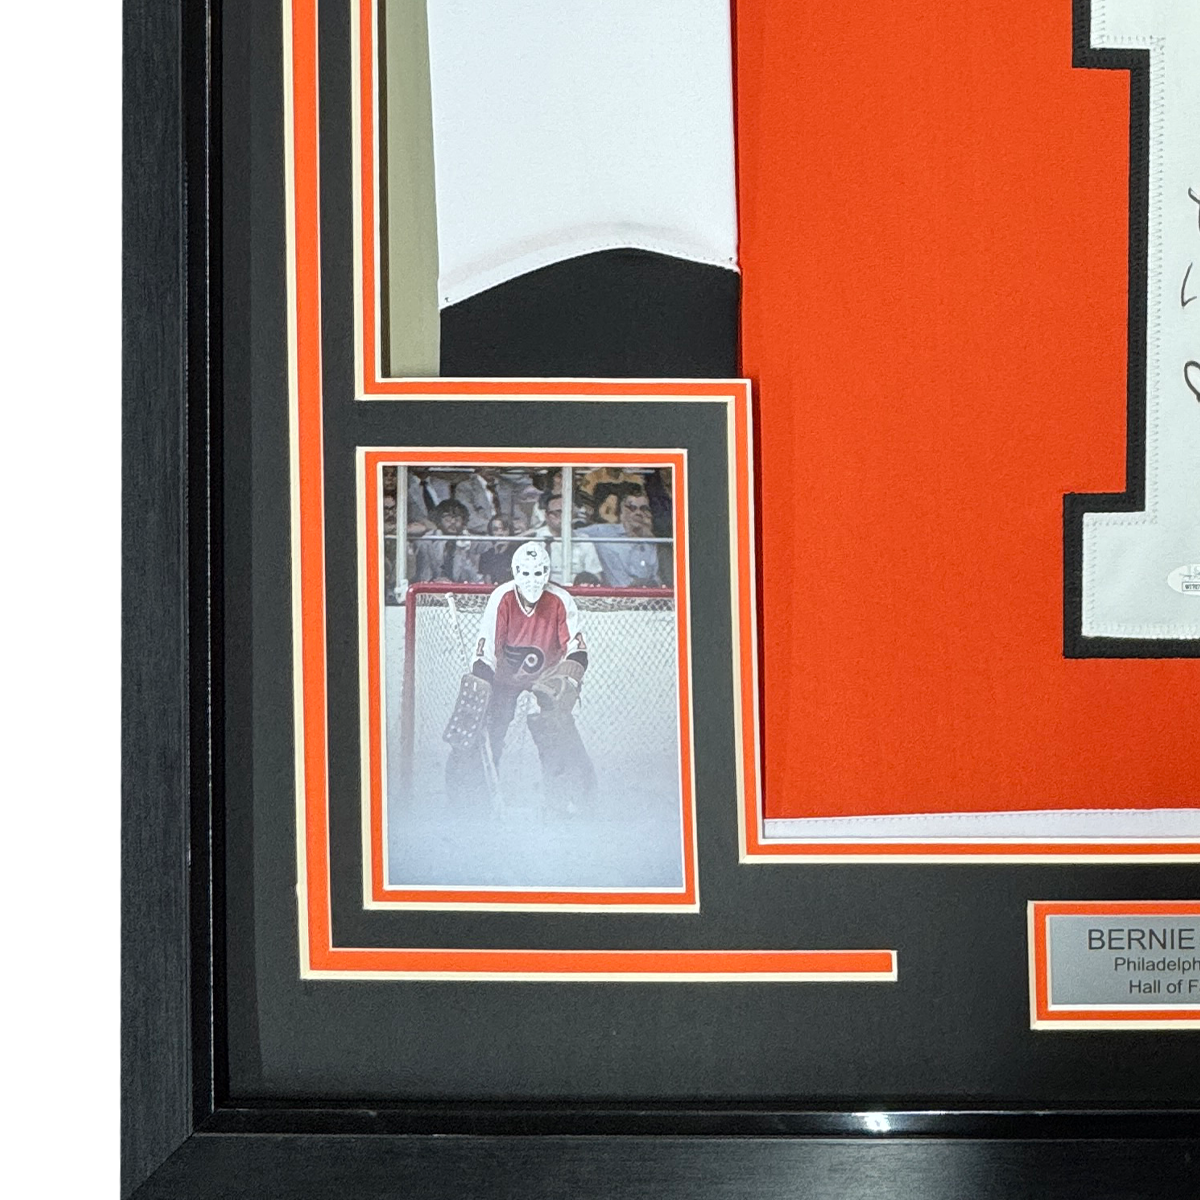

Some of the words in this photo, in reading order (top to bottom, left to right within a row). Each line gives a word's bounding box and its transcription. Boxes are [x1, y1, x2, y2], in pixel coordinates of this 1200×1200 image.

[1087, 928, 1196, 950] BERNIE
[1129, 979, 1161, 994] Hall
[1166, 979, 1184, 994] of
